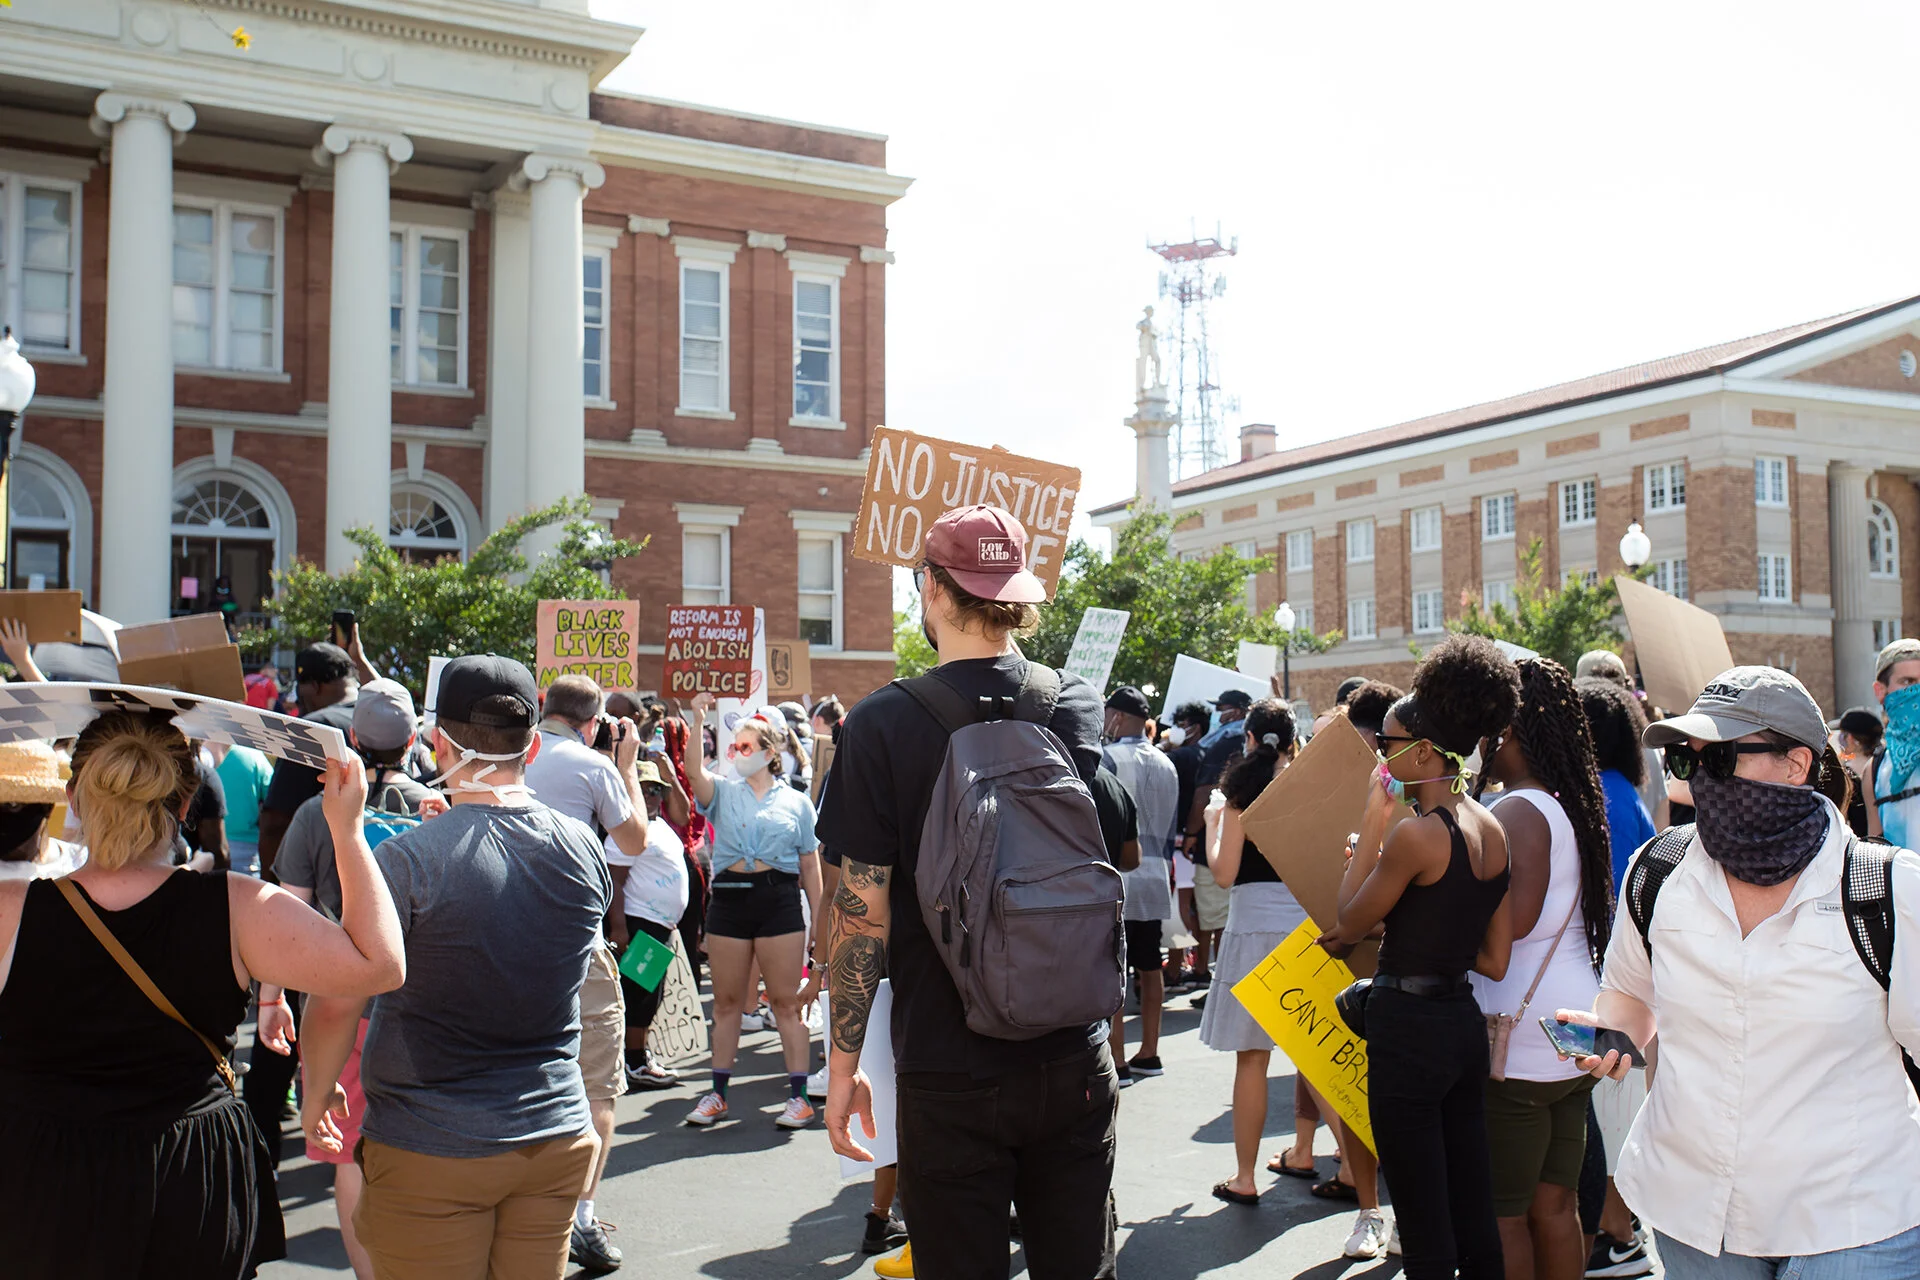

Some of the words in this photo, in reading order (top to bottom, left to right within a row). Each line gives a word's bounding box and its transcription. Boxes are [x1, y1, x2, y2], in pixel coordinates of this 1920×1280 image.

[873, 437, 935, 500] NO
[941, 452, 1076, 535] JUSTICE
[866, 500, 923, 560] NO
[980, 551, 1010, 561] CARD
[981, 542, 1004, 553] LOW
[557, 608, 625, 632] BLACK
[670, 609, 719, 626] REFORM
[722, 609, 742, 626] IS
[554, 631, 630, 658] LIVES
[668, 626, 694, 639] NOT
[698, 626, 748, 642] ENOUGH
[667, 639, 750, 662] ABOLISH
[693, 661, 710, 670] the
[672, 670, 747, 693] POLICE
[1279, 988, 1343, 1047] CAN'T
